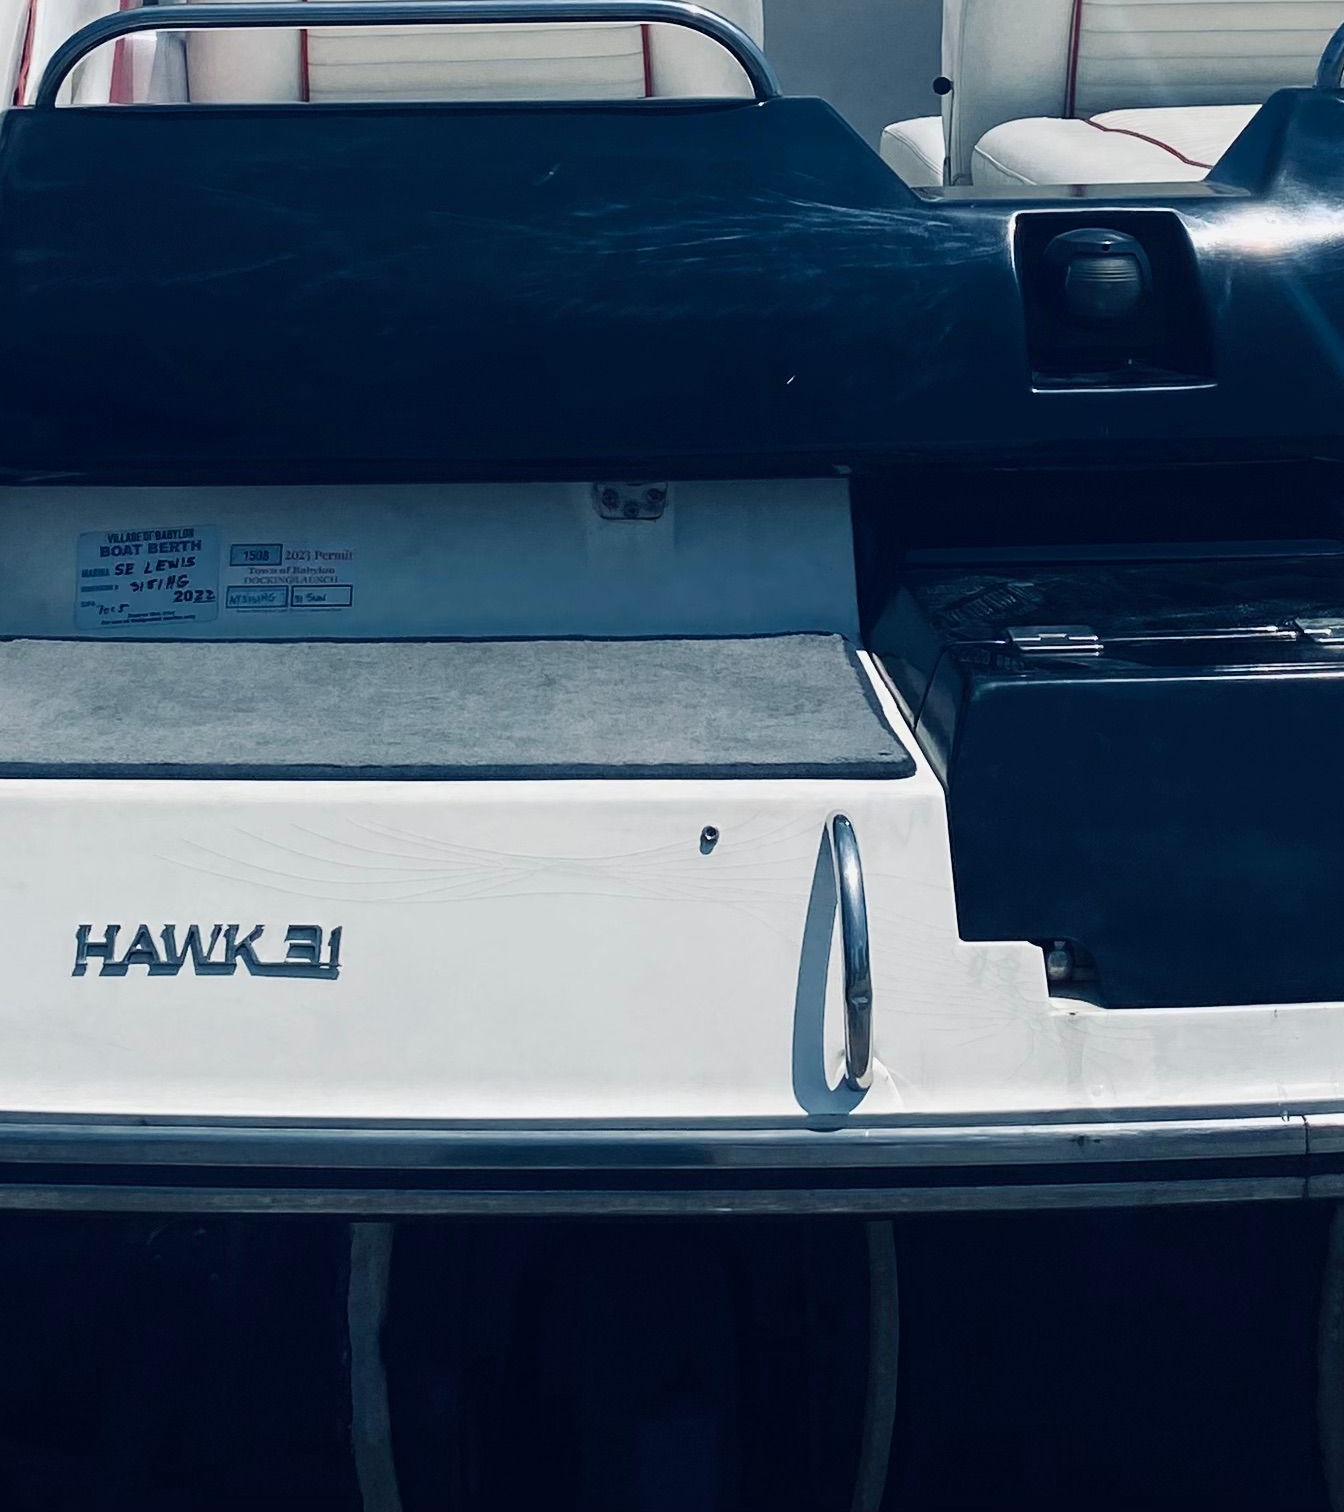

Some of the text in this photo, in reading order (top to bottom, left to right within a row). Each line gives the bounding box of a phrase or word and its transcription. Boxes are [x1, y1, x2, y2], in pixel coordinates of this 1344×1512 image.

[107, 533, 141, 544] VILLAGE
[154, 528, 195, 540] BABYLON
[99, 540, 202, 557] BOAT BERTH
[313, 549, 353, 561] Permit
[114, 556, 197, 576] SE LEWIS
[291, 566, 336, 575] Babylon
[172, 588, 216, 604] 2022
[71, 924, 265, 977] HAWK
